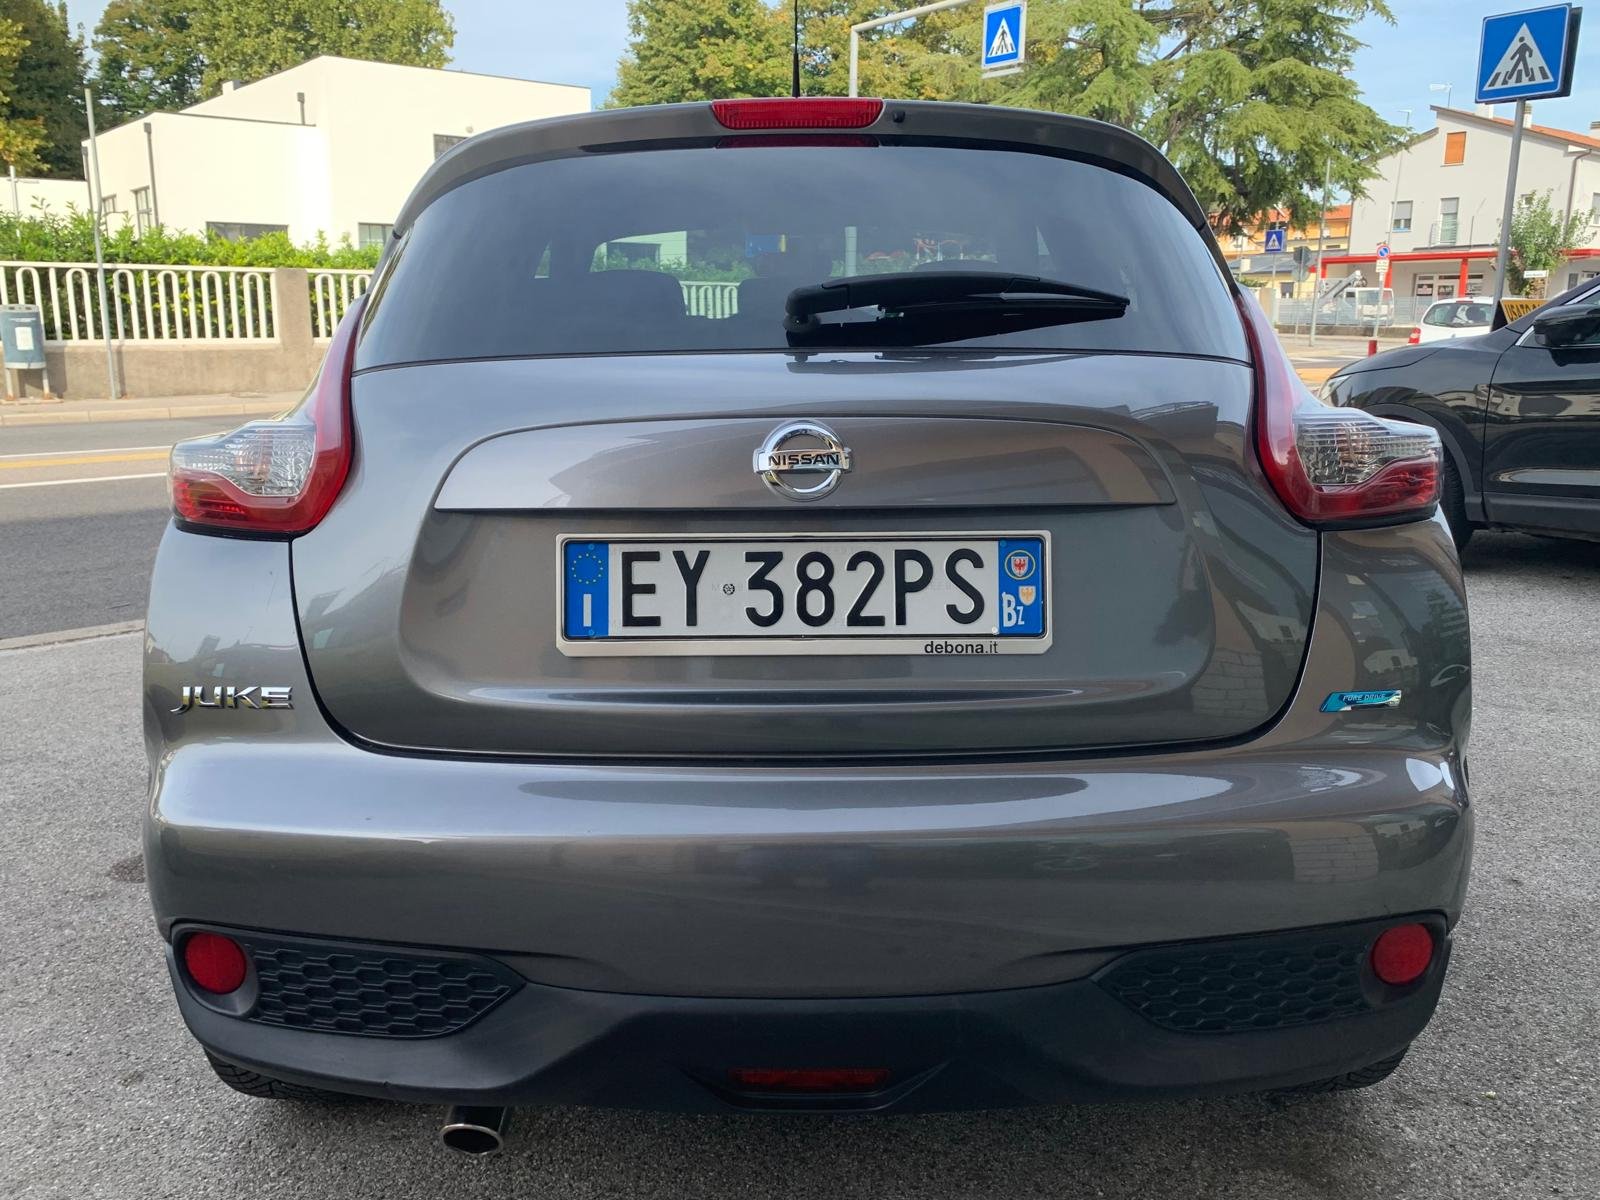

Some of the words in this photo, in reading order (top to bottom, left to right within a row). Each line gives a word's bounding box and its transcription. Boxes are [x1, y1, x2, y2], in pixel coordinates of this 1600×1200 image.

[768, 454, 840, 466] NISSAN
[621, 550, 711, 627] EY
[744, 548, 985, 627] 382PS
[924, 640, 999, 654] debona.it
[169, 686, 294, 714] JUKE
